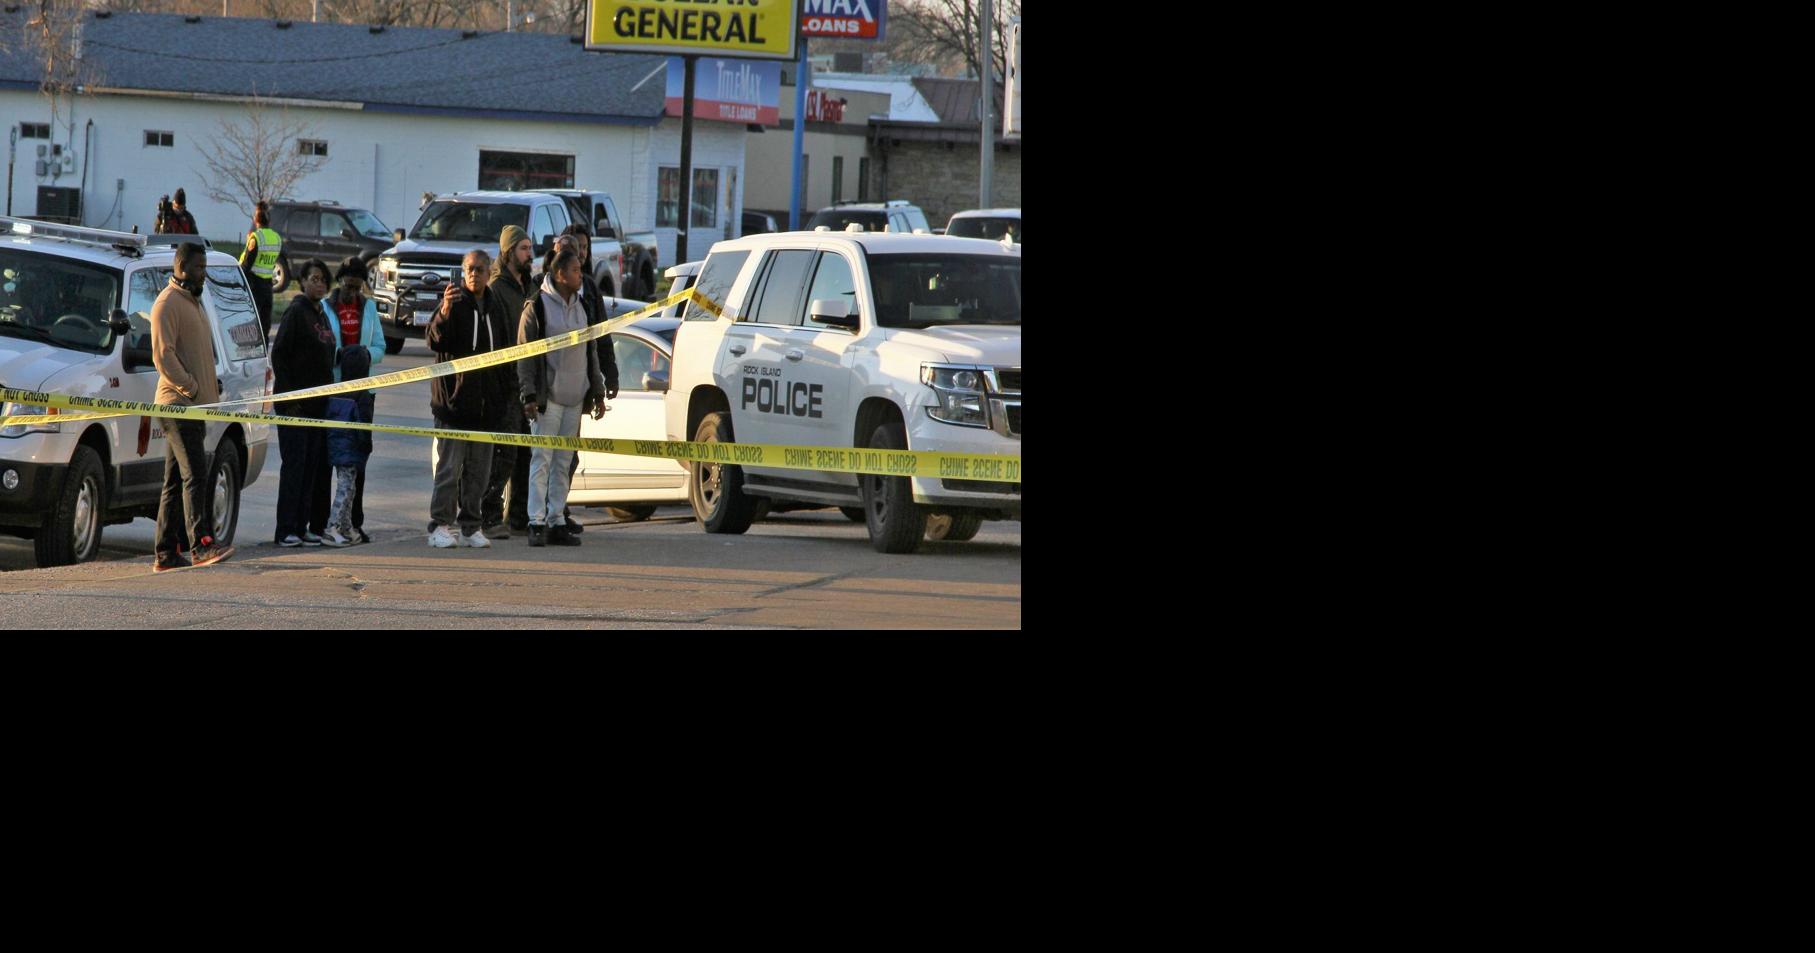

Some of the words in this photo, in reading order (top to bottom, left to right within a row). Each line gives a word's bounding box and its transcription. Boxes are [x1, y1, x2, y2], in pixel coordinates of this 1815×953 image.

[614, 6, 766, 44] GENERAL
[720, 103, 736, 119] TITLE
[736, 105, 756, 120] LOANS
[258, 253, 277, 265] POLI
[743, 365, 759, 375] ROCK
[760, 366, 782, 377] ISLAND
[741, 377, 824, 418] POLICE
